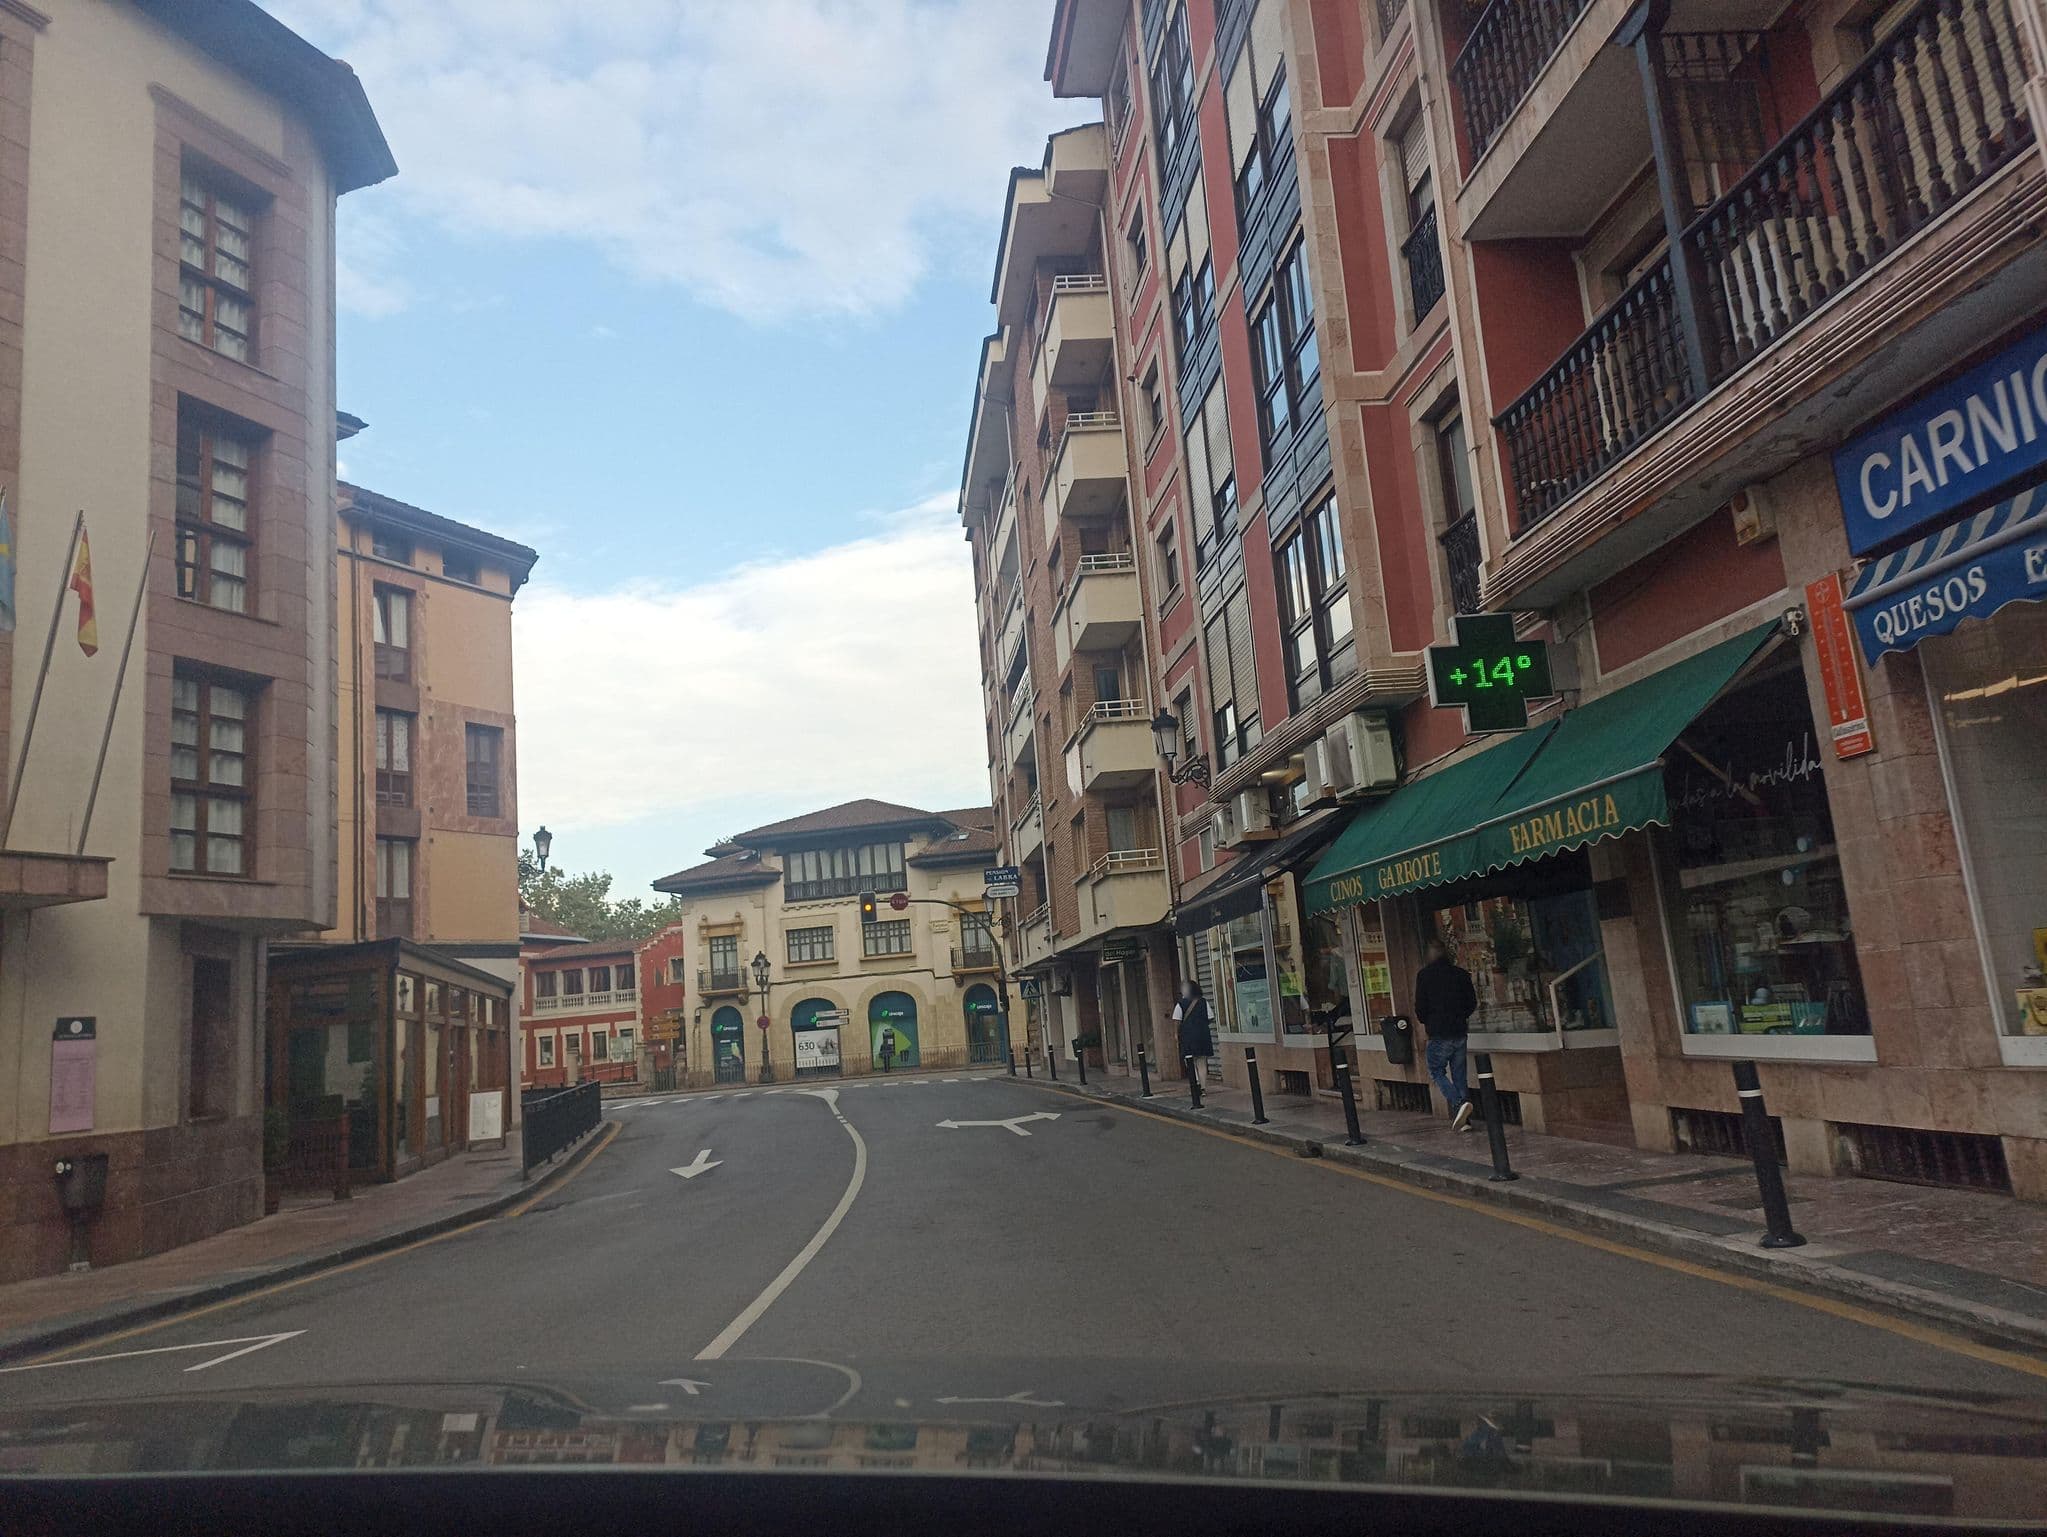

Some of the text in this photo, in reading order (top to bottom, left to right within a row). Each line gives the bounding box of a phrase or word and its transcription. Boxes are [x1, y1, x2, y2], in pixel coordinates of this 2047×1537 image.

[1873, 566, 1987, 645] QUESOS
[1750, 731, 1824, 792] movilida
[1330, 793, 1620, 902] CINOS GARROTE FARMACIA
[798, 1041, 815, 1051] 630
